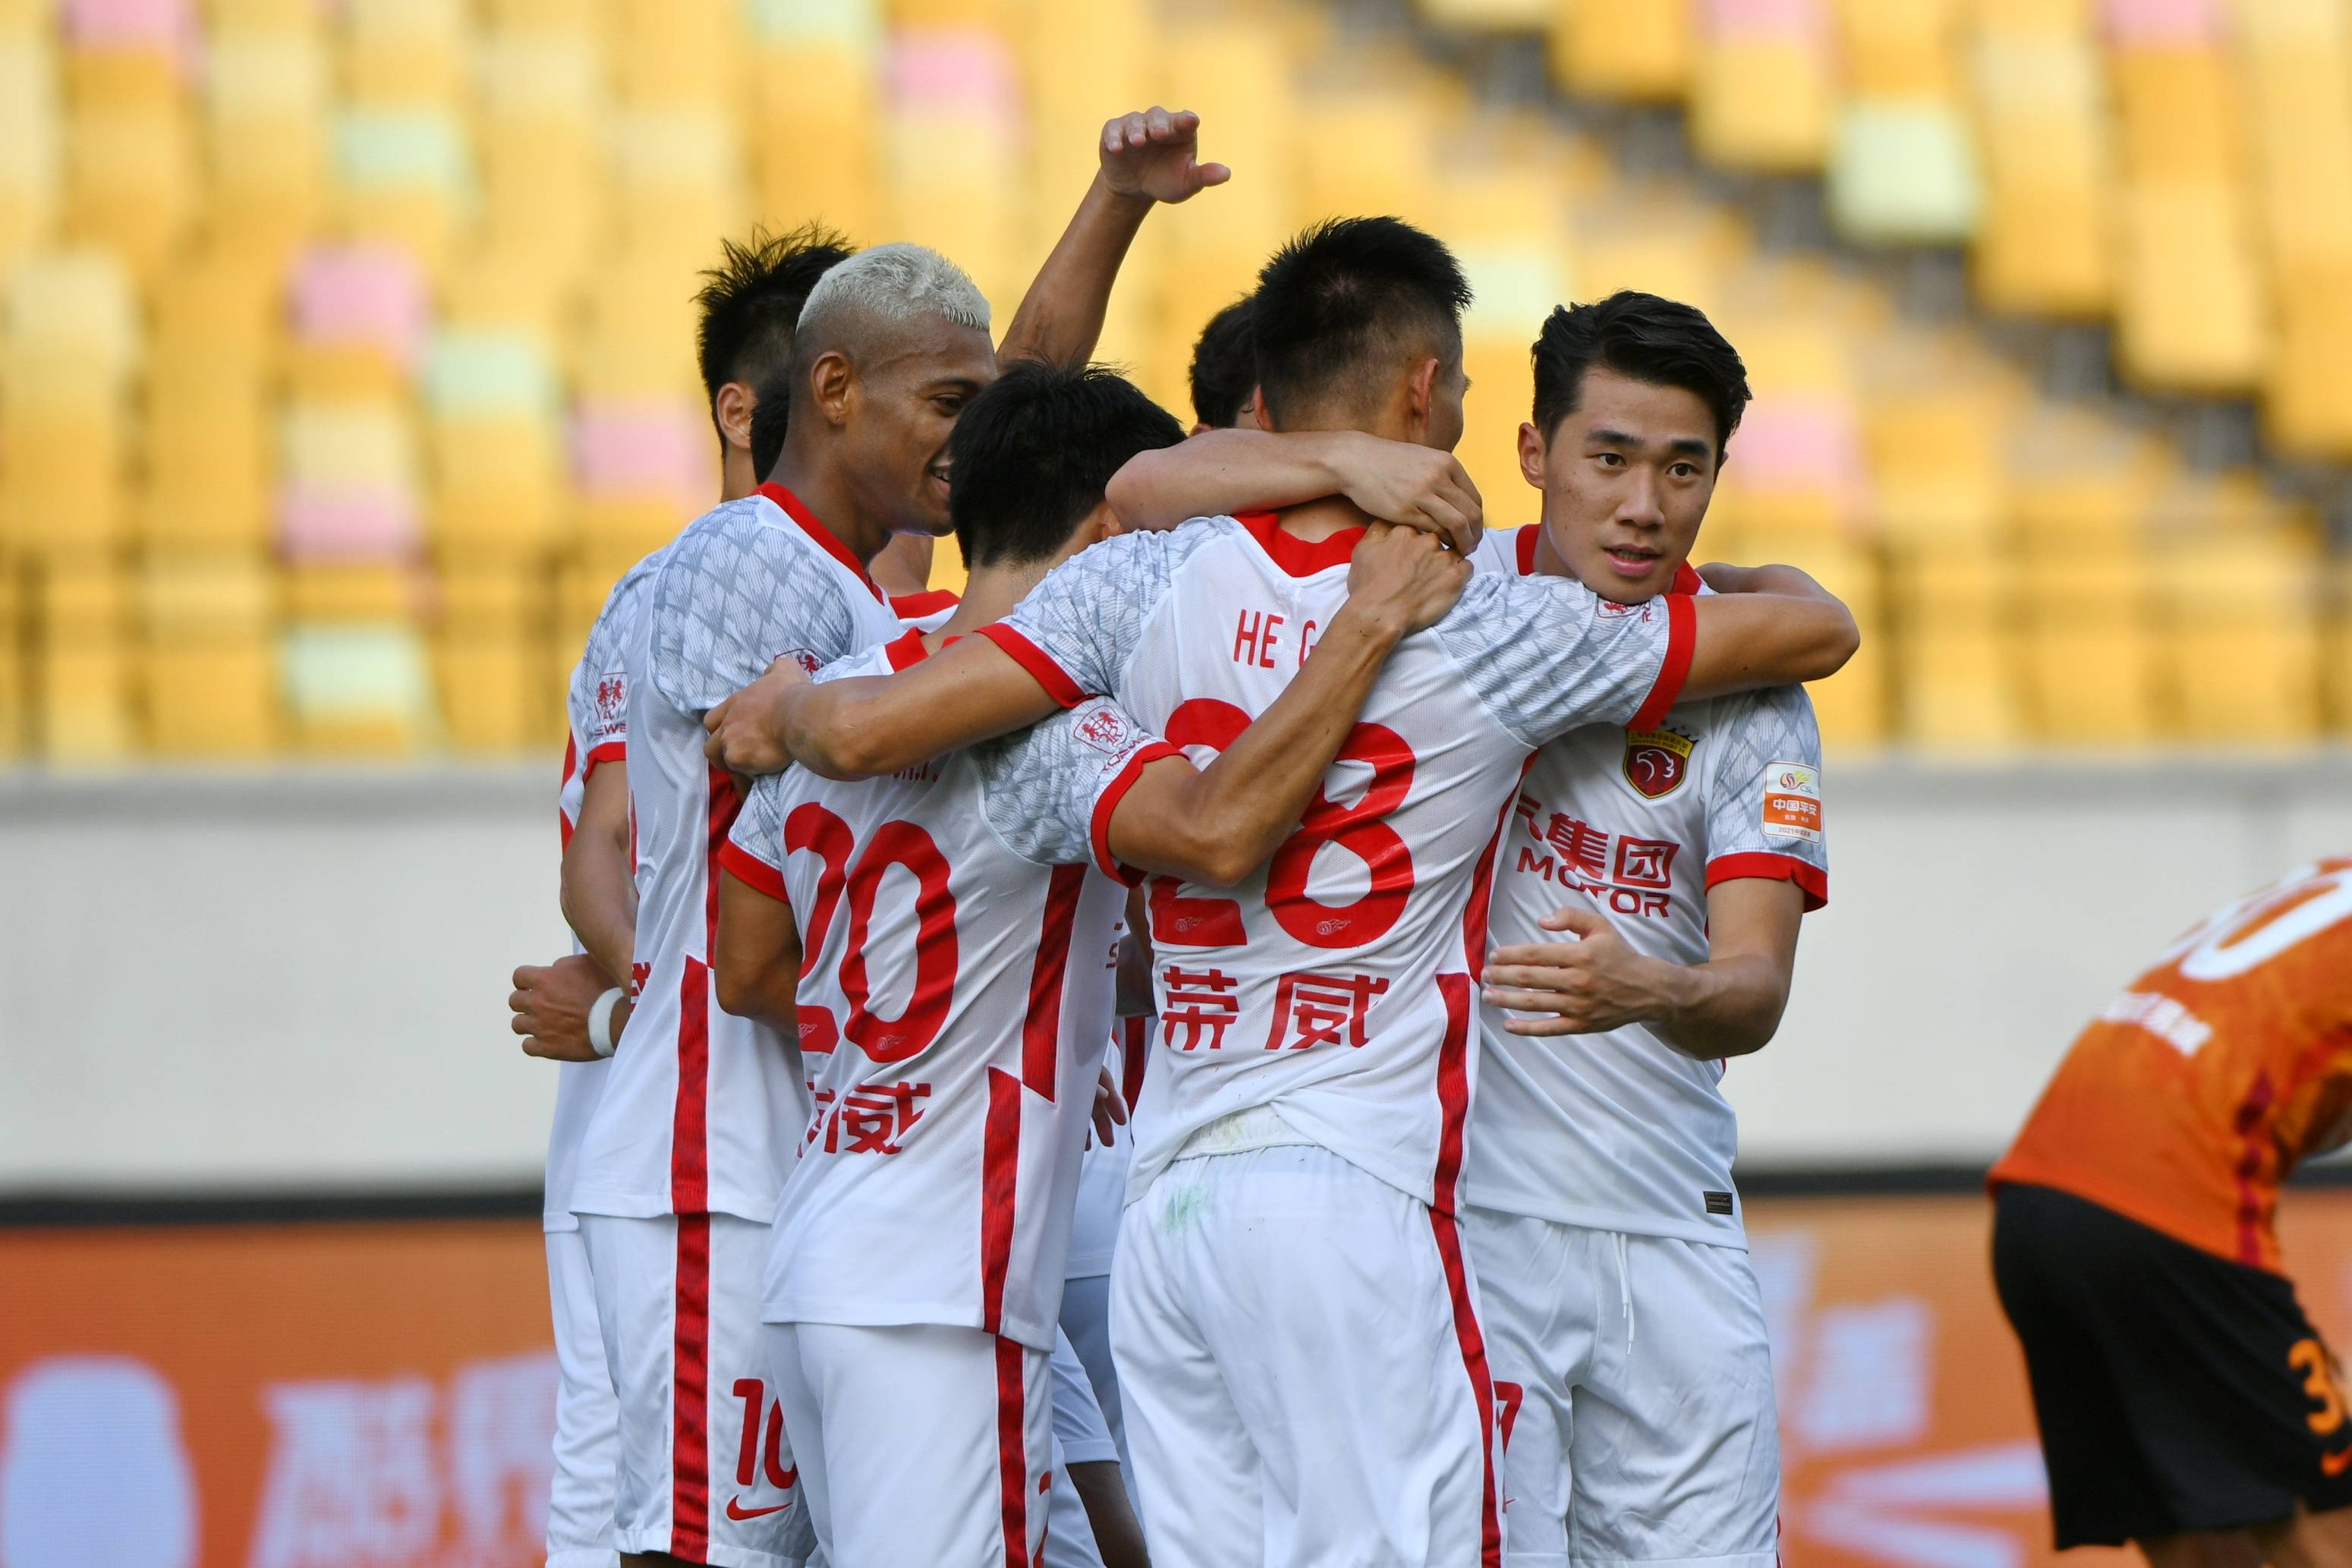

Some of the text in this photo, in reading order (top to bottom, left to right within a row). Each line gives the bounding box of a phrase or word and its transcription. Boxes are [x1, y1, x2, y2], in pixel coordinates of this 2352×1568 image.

[1233, 609, 1284, 669] HE
[1773, 798, 1816, 816] 中国平安
[1516, 846, 1670, 918] MOTOR
[783, 801, 959, 1063] 20
[1160, 965, 1390, 1050] 荣威
